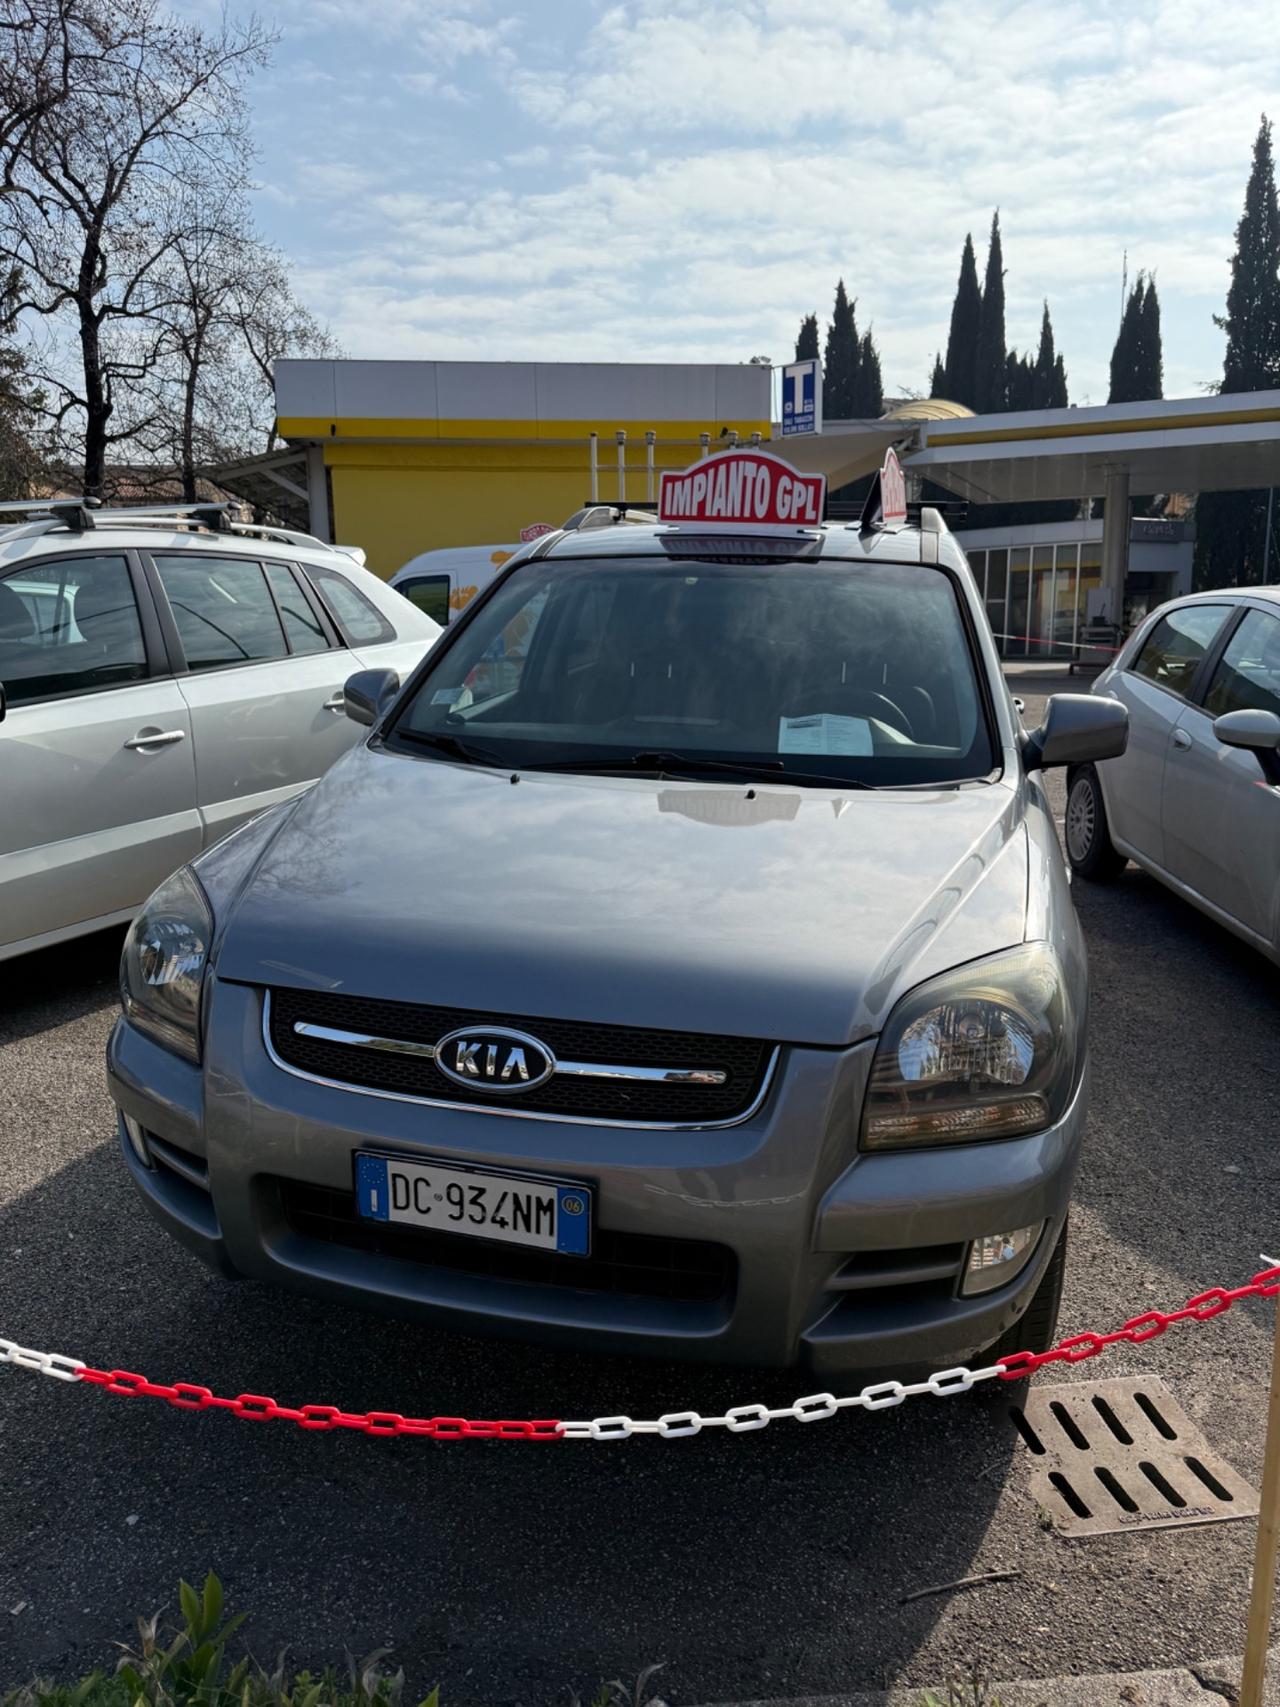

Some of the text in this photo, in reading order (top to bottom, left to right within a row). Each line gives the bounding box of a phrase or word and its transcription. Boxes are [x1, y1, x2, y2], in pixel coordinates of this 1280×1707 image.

[785, 363, 813, 414] T
[665, 460, 816, 520] IMPIANTO GPL
[455, 1040, 530, 1080] KIA
